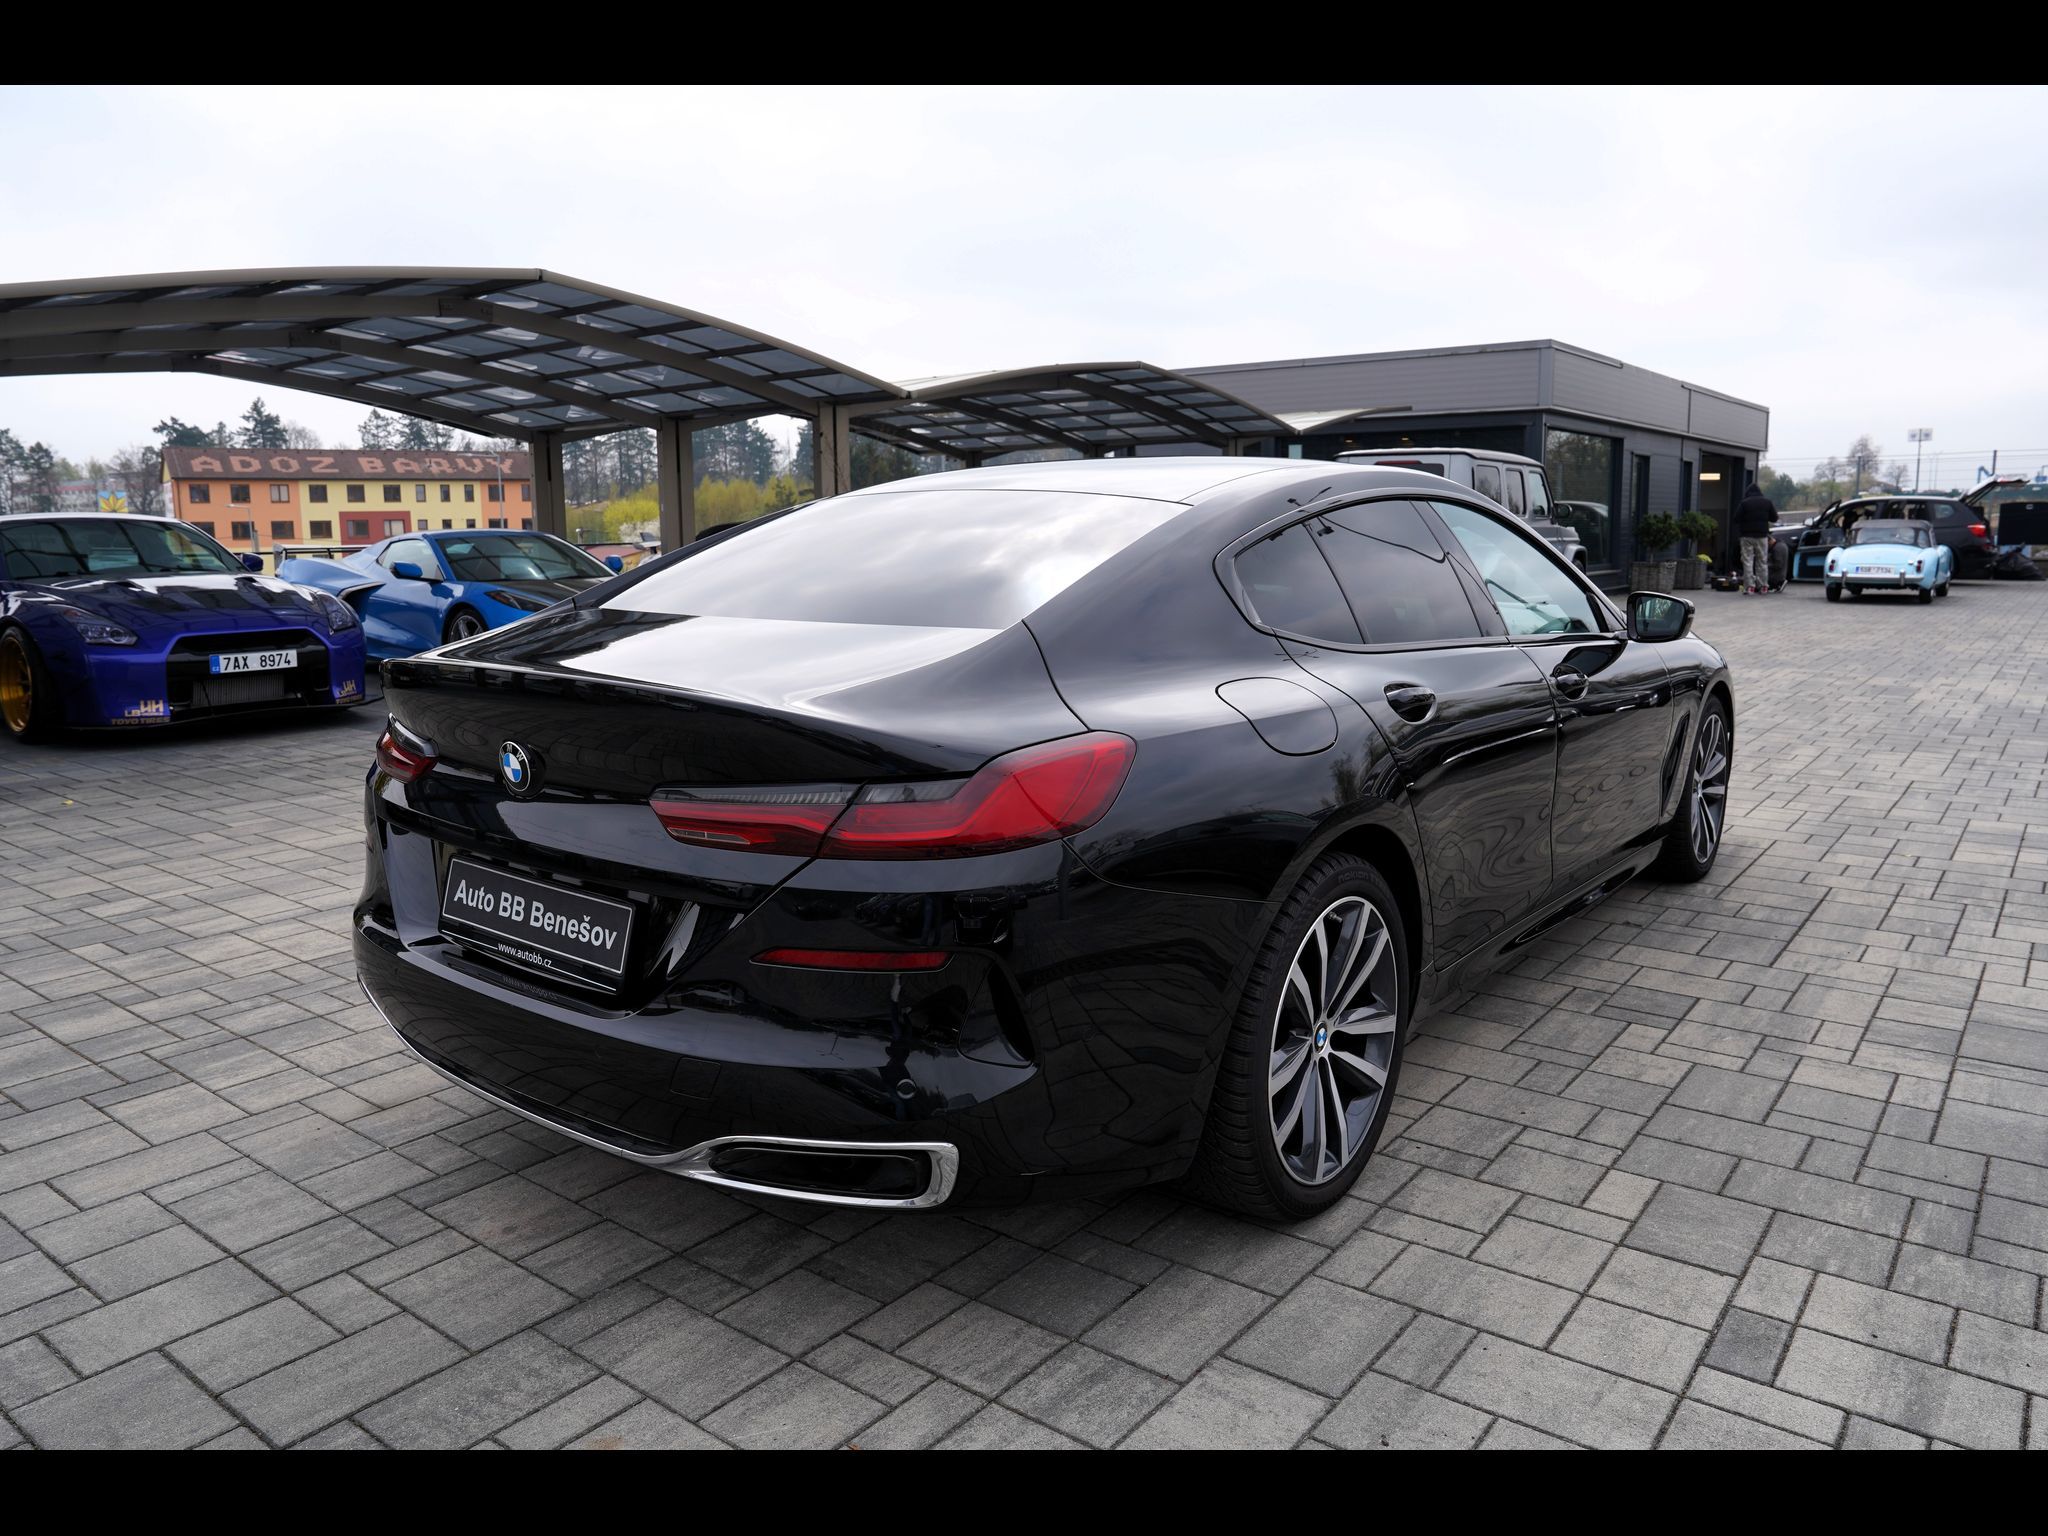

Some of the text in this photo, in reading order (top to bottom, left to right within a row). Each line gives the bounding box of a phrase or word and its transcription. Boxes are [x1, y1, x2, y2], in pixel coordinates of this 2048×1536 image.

[190, 455, 514, 474] ADOZ BARVY
[223, 653, 291, 671] 7AX 8974
[453, 879, 617, 950] Auto BB Benešov
[497, 942, 552, 968] www.autobb.cz
